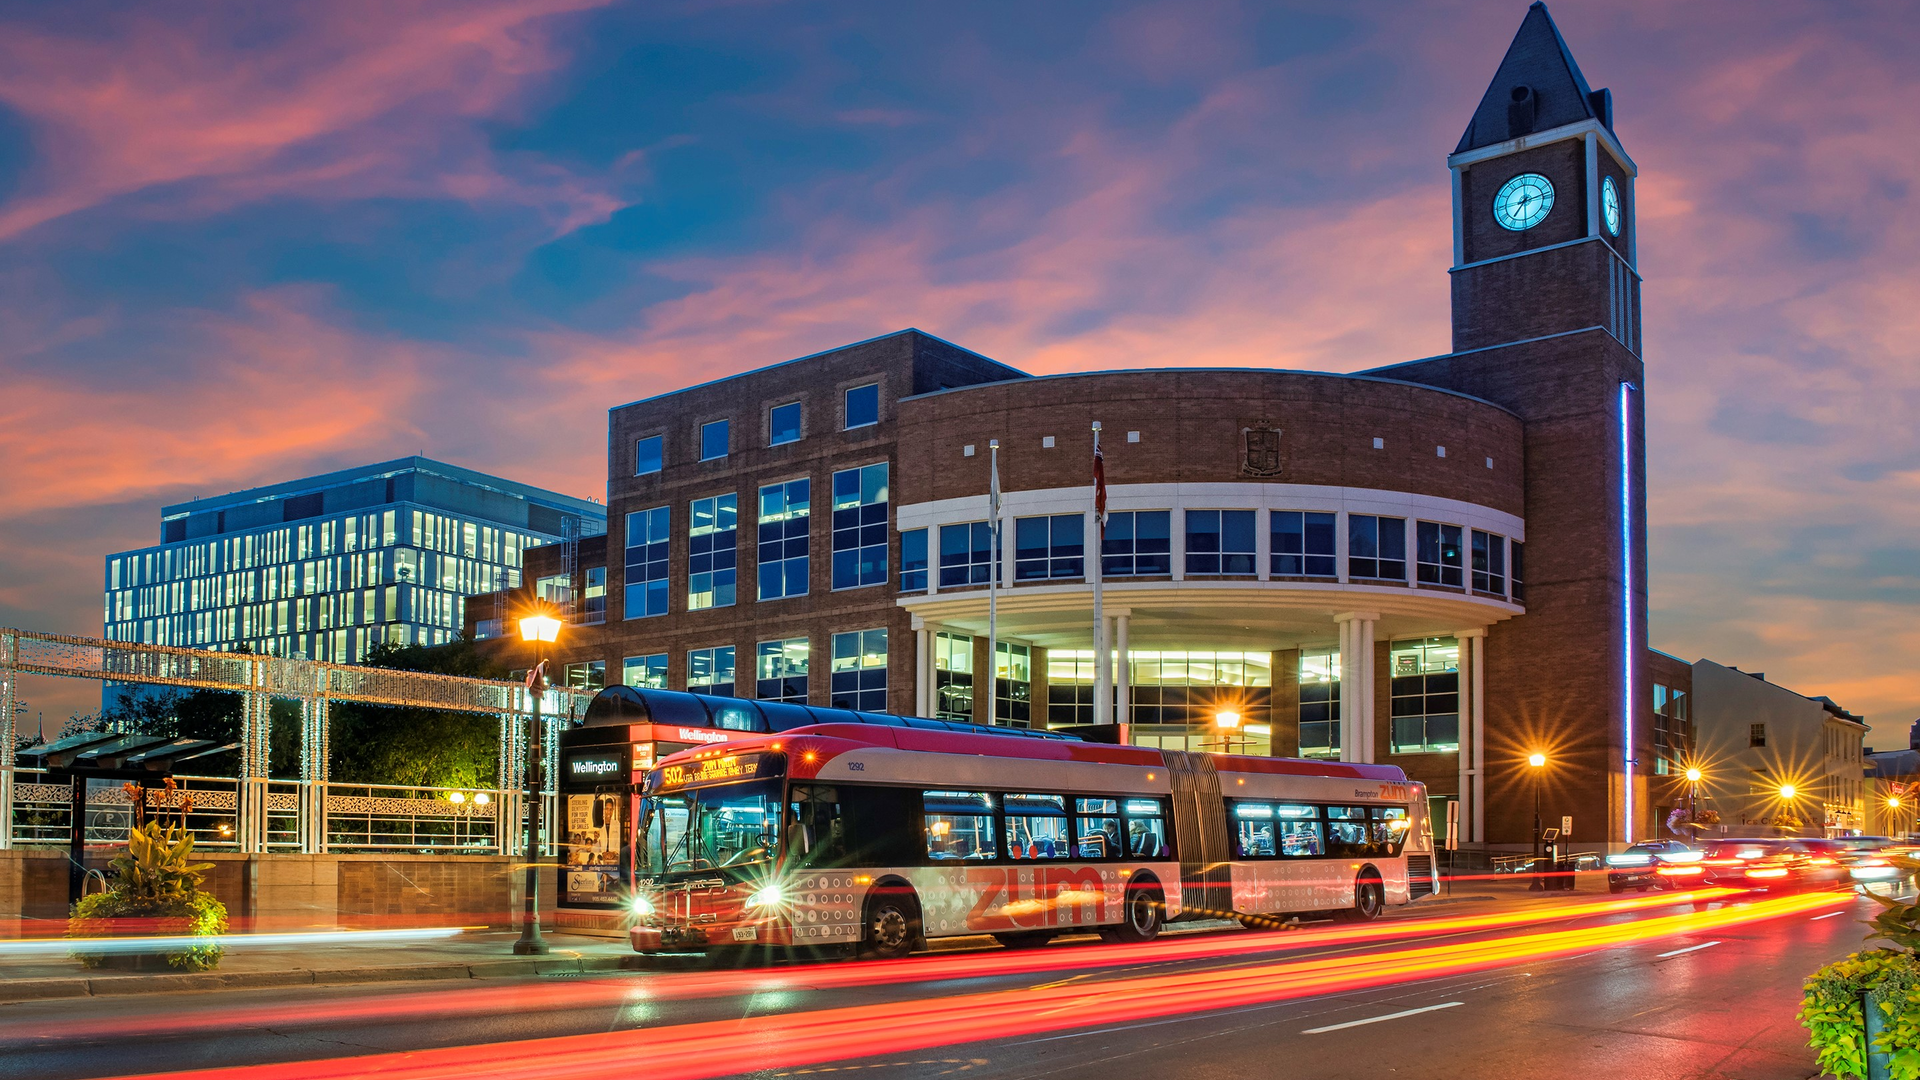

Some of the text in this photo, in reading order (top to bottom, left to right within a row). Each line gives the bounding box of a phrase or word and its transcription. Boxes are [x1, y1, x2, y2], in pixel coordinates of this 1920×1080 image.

[679, 728, 728, 743] Wellington
[572, 760, 618, 774] Wellington
[848, 762, 865, 772] 1292
[664, 765, 684, 785] 502
[1354, 789, 1379, 800] Brampton
[106, 813, 115, 823] P
